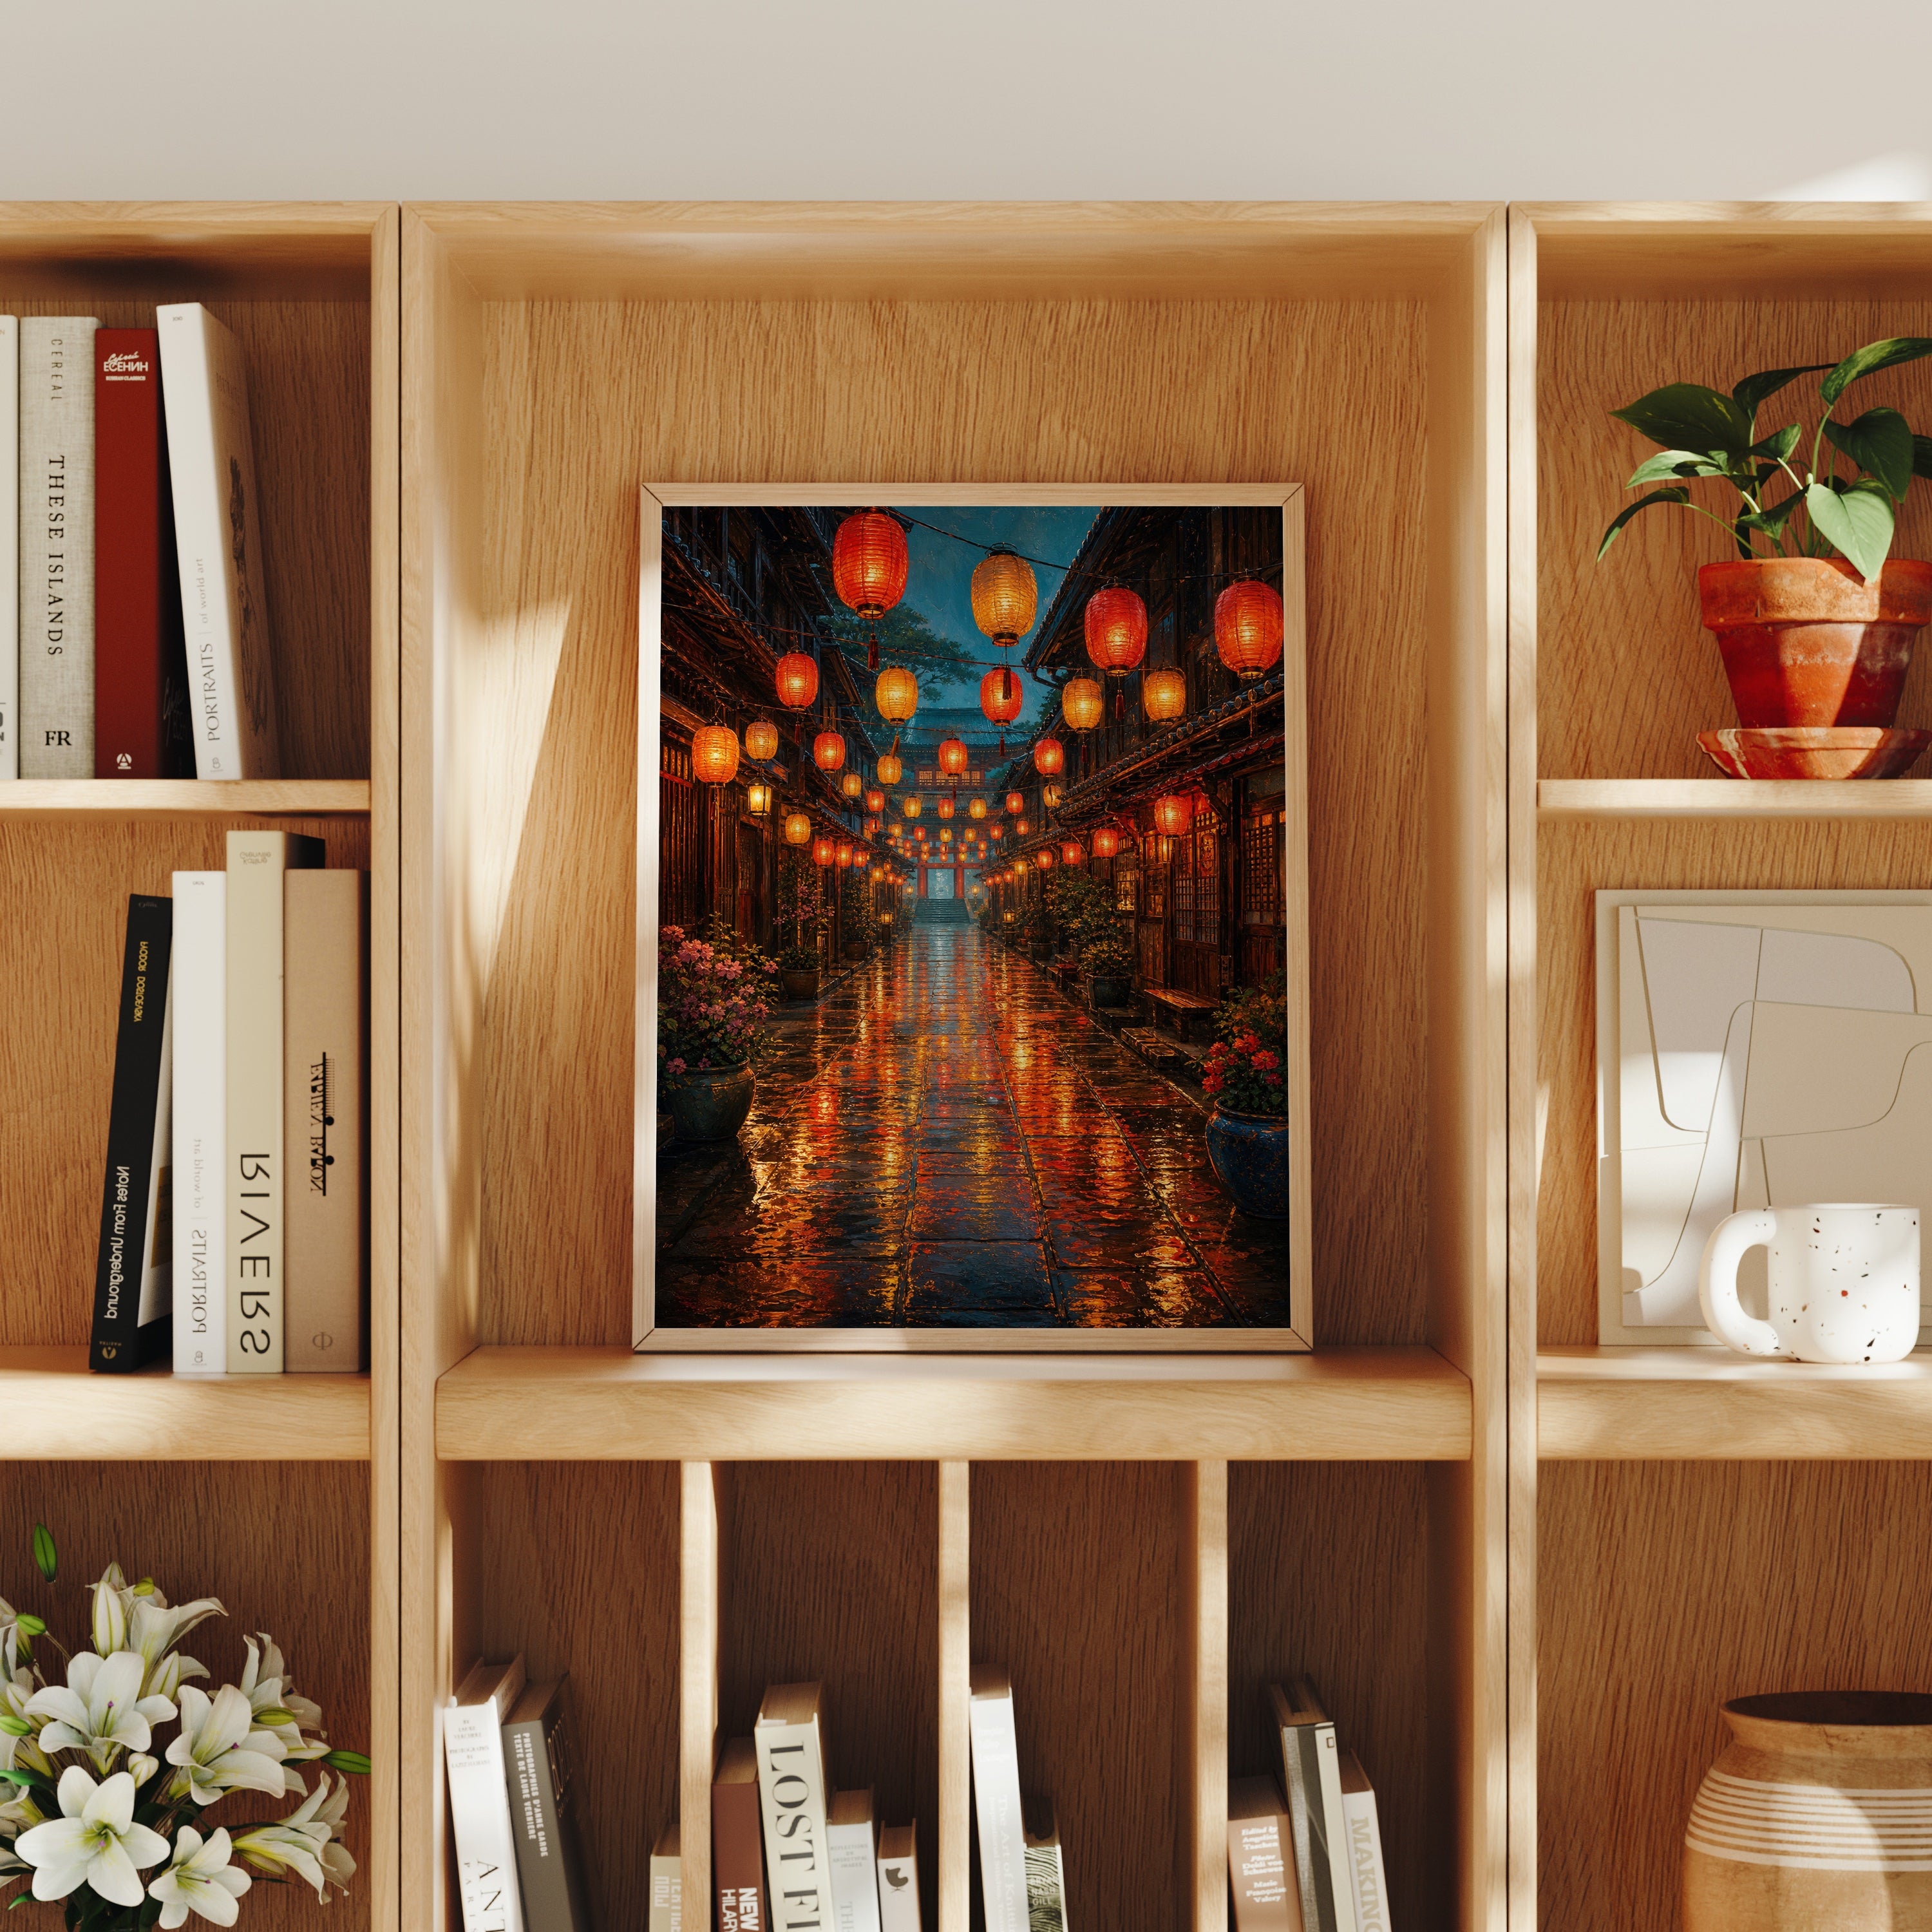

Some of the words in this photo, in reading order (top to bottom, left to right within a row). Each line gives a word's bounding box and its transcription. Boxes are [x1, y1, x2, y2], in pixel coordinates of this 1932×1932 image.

[51, 339, 62, 401] CEREAL
[103, 361, 149, 372] ЕСЕНИН
[48, 455, 65, 540] THESE
[195, 558, 204, 574] art
[48, 553, 64, 656] ISLANDS
[196, 578, 207, 609] world
[199, 643, 221, 742] PORTRAITS
[45, 730, 72, 746] FR
[513, 1734, 522, 1759] TEXTE
[517, 1760, 525, 1772] DE
[519, 1774, 528, 1799] LAURE
[522, 1732, 538, 1797] PHOTOGRAPHIES
[537, 1831, 548, 1857] GARDE
[769, 1741, 816, 1871] LOST
[998, 1794, 1009, 1825] The
[1001, 1830, 1010, 1858] Art
[739, 1888, 759, 1931] NEW
